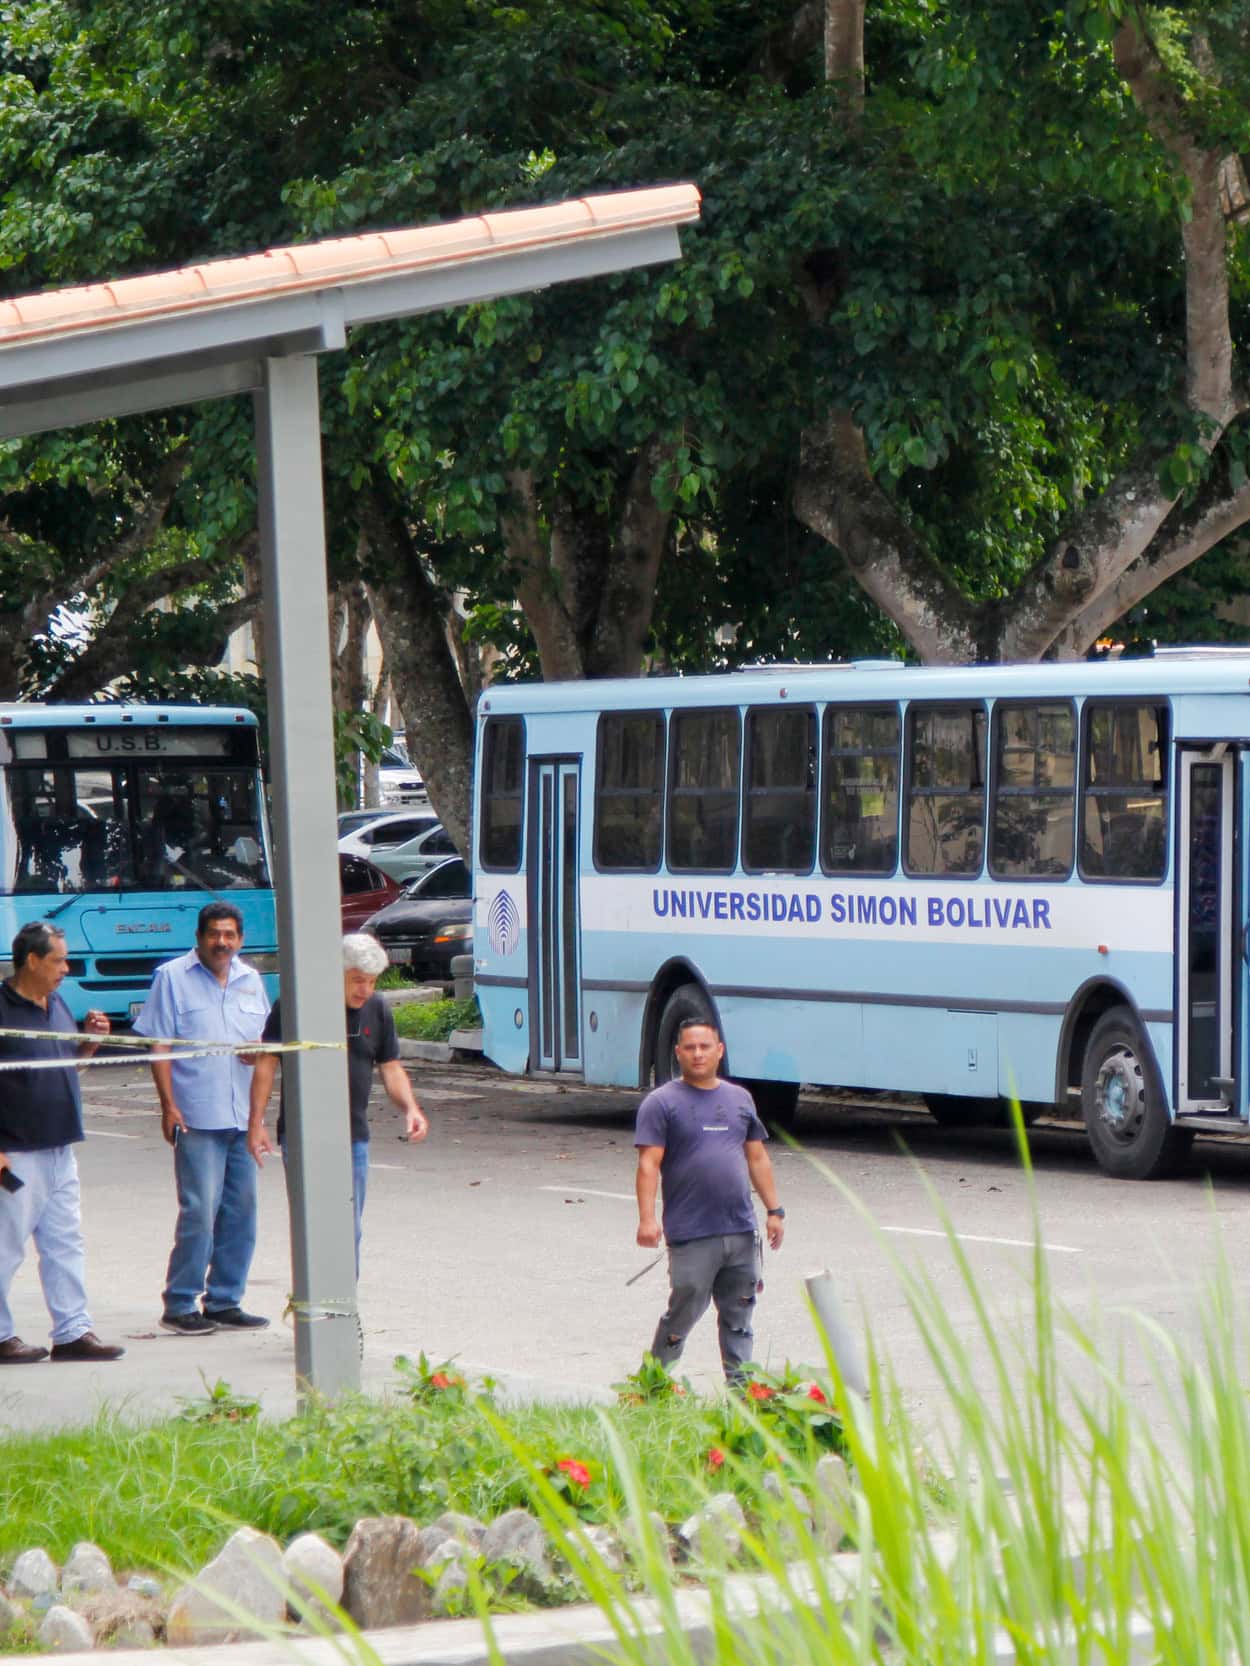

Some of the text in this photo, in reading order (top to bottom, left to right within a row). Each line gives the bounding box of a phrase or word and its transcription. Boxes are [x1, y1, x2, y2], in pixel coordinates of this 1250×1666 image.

[97, 735, 167, 751] U.S.B.
[652, 889, 1052, 929] UNIVERSIDAD SIMON BOLIVAR
